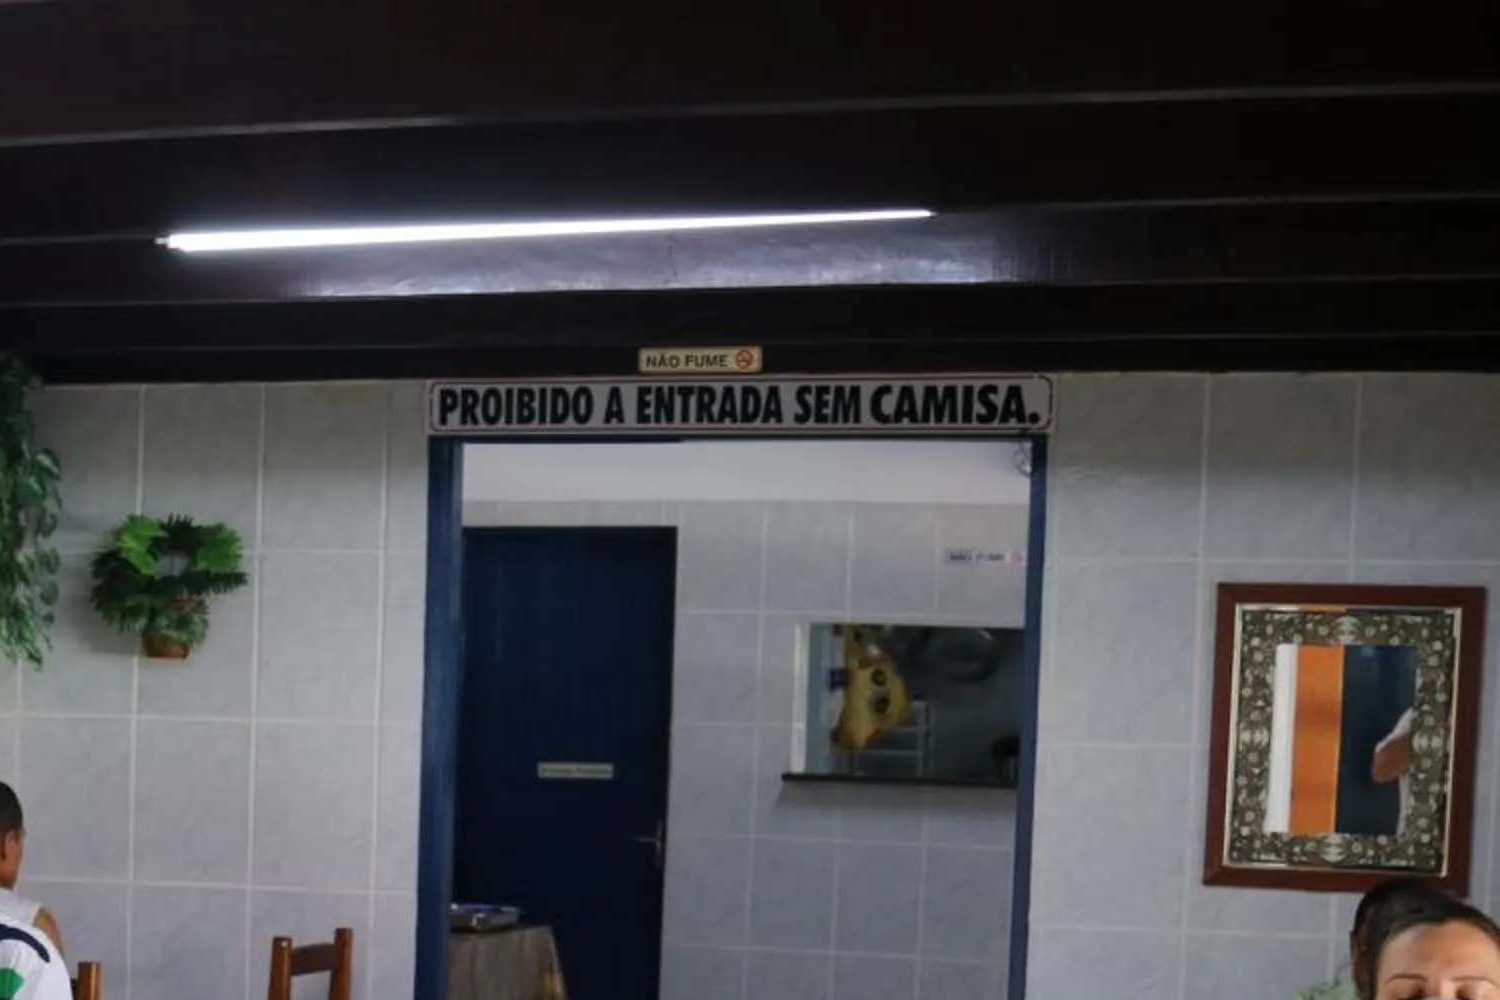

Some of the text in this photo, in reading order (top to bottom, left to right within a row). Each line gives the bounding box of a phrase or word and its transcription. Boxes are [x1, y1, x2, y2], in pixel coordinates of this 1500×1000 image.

[645, 352, 728, 369] NÃO FUME
[438, 384, 1040, 426] PROIBIDO A ENTRADA SEM CAMISA.
